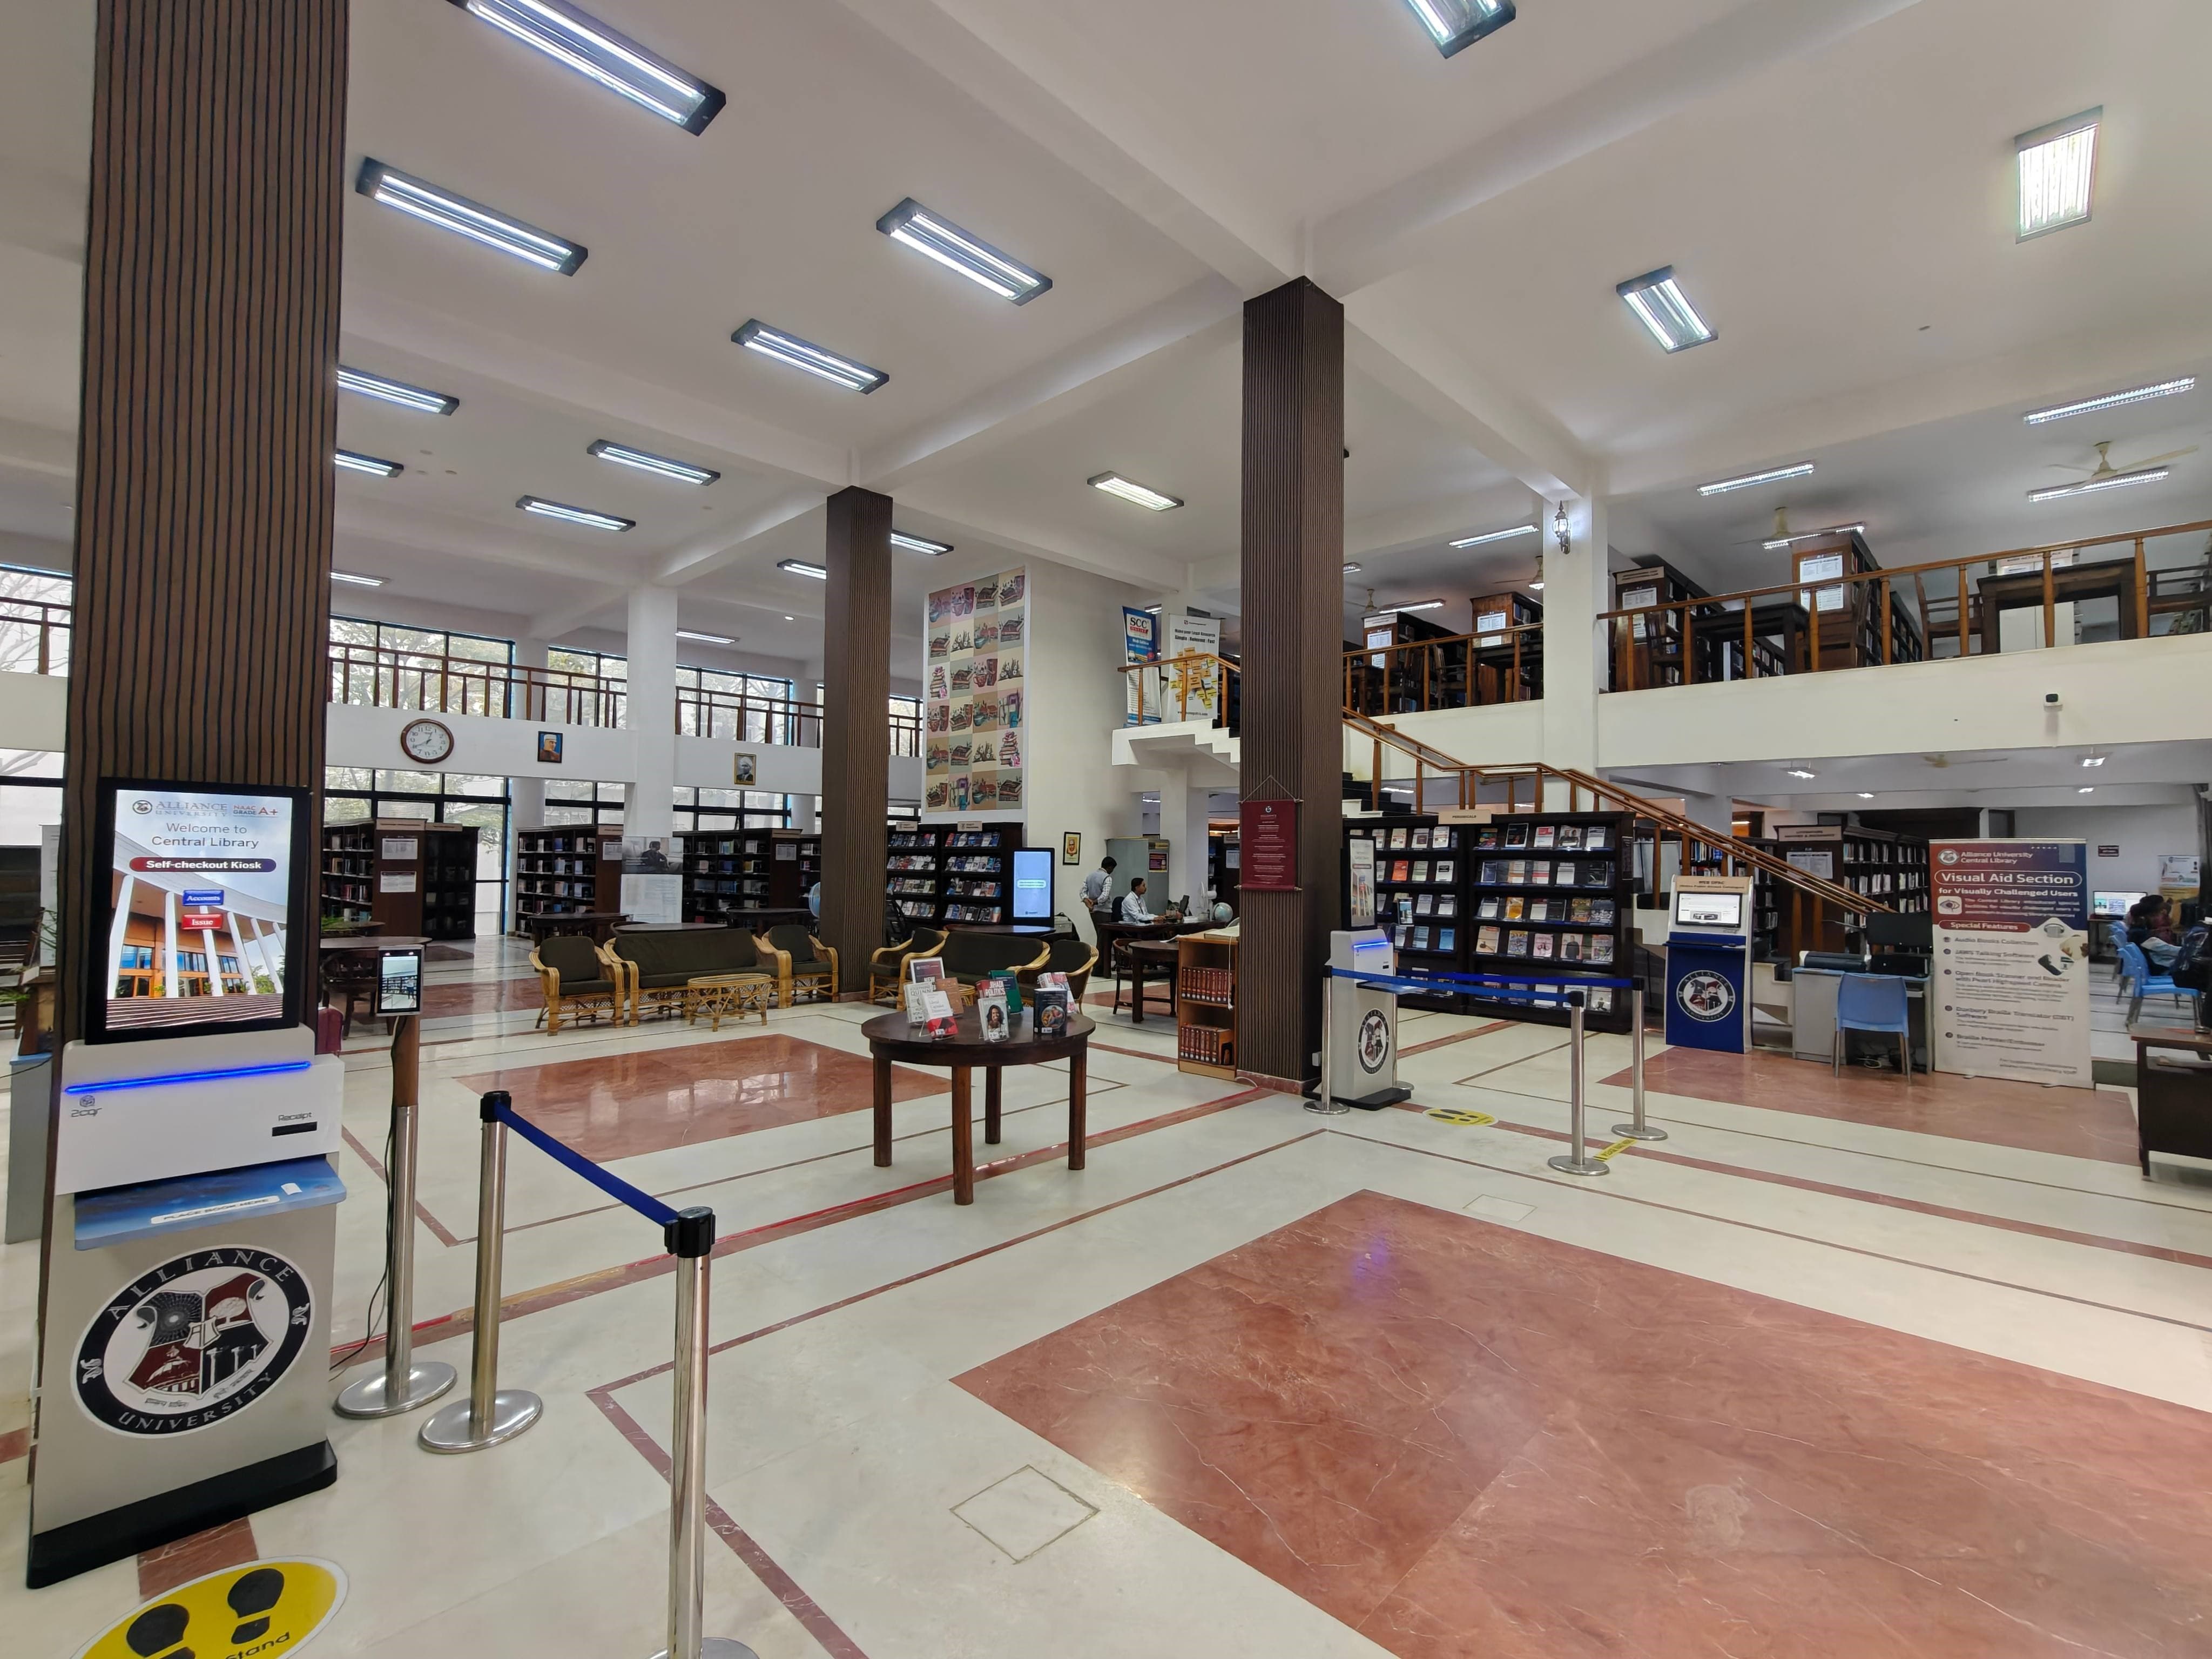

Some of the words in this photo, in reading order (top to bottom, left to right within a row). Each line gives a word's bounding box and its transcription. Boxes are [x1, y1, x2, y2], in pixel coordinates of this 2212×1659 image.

[1130, 617, 1147, 629] SCC
[156, 801, 228, 810] ALLIANCE
[258, 807, 279, 815] A+
[166, 822, 230, 834] Welcome
[234, 824, 247, 834] to
[151, 837, 205, 846] Central
[210, 838, 259, 849] Library
[146, 860, 228, 869] Self-checkout
[231, 861, 262, 869] Kiosk
[1941, 872, 1985, 882] Visual
[1989, 873, 2013, 883] Aid
[2017, 874, 2074, 885] Section
[1954, 888, 1992, 896] Visually
[1994, 888, 2048, 897] Challenged
[1950, 921, 1980, 929] Special
[985, 988, 1006, 996] POLITICS
[278, 1112, 312, 1121] Receipt
[107, 1250, 294, 1320] ALLIANCE
[118, 1372, 272, 1431] UNIVERSITY
